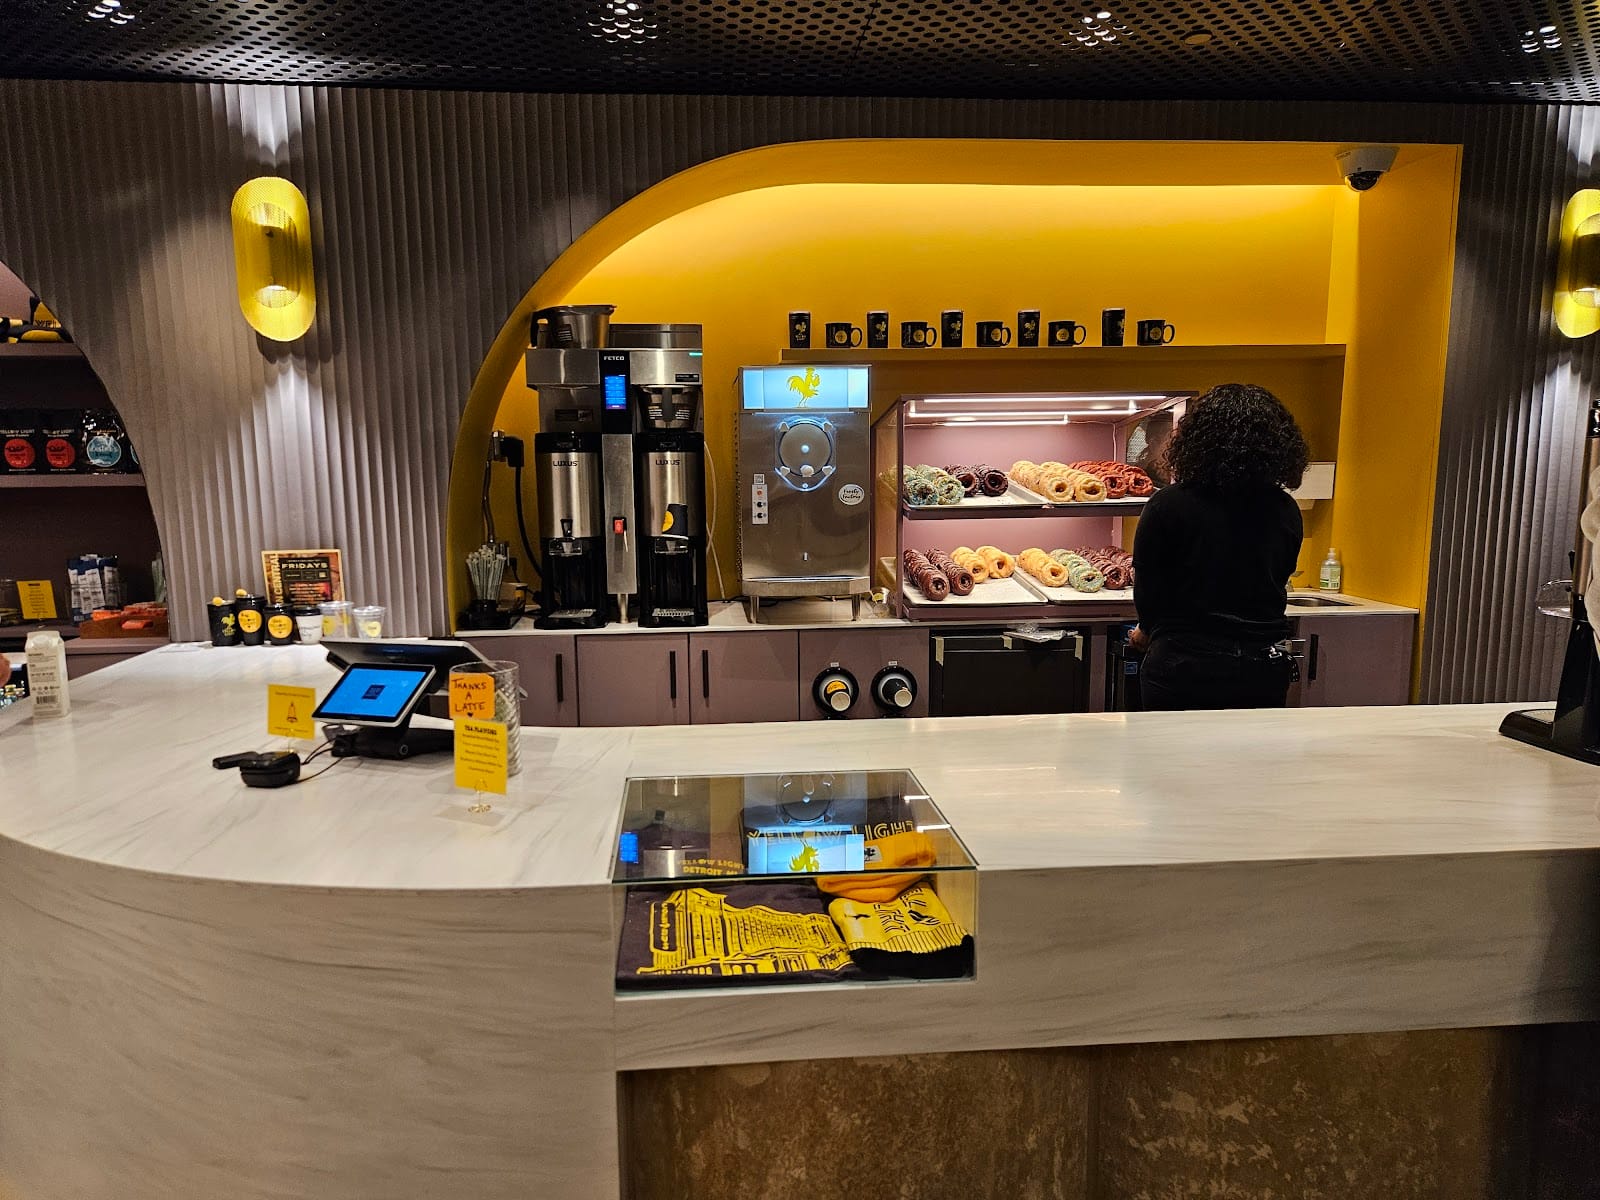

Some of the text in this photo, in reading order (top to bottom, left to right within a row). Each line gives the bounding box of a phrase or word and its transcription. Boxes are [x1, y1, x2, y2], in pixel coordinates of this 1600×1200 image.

[269, 553, 284, 595] CENTRAL
[451, 677, 488, 690] THANKS
[465, 691, 473, 700] A
[455, 701, 486, 712] LATTE
